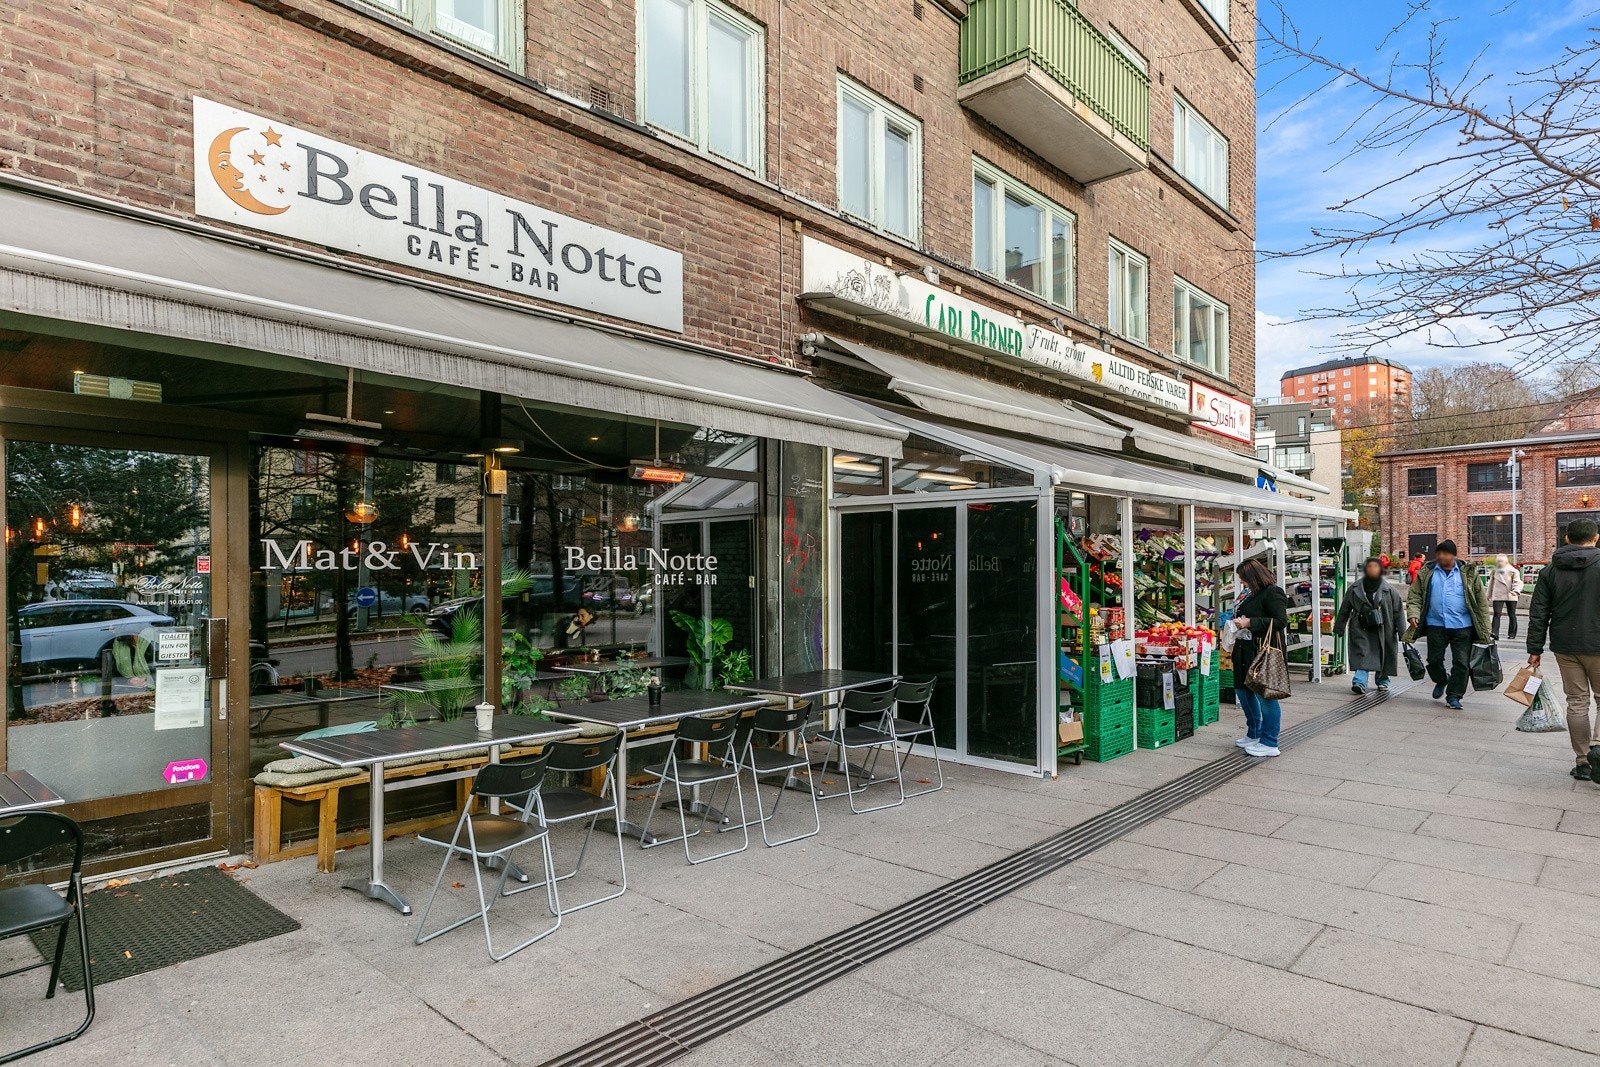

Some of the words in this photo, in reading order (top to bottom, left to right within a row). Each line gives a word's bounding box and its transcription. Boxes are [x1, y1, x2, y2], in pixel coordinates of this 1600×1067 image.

[297, 142, 488, 247] Bella
[506, 208, 662, 295] Notte
[407, 234, 480, 272] CAFÉ
[511, 262, 559, 293] BAR
[971, 309, 1023, 358] BERNER
[1108, 360, 1135, 381] ALLTID
[1137, 370, 1164, 392] FERSKE
[1165, 381, 1187, 400] VARER
[1209, 397, 1236, 429] Sushi
[259, 537, 362, 572] Mat
[363, 540, 401, 571] &
[407, 541, 478, 572] Vin
[564, 545, 638, 571] Bella
[645, 547, 719, 571] Notte
[134, 574, 174, 596] Bella
[173, 575, 204, 592] Notte
[654, 572, 685, 586] CAFÉ
[695, 573, 719, 586] BAR
[172, 764, 200, 773] foodora
